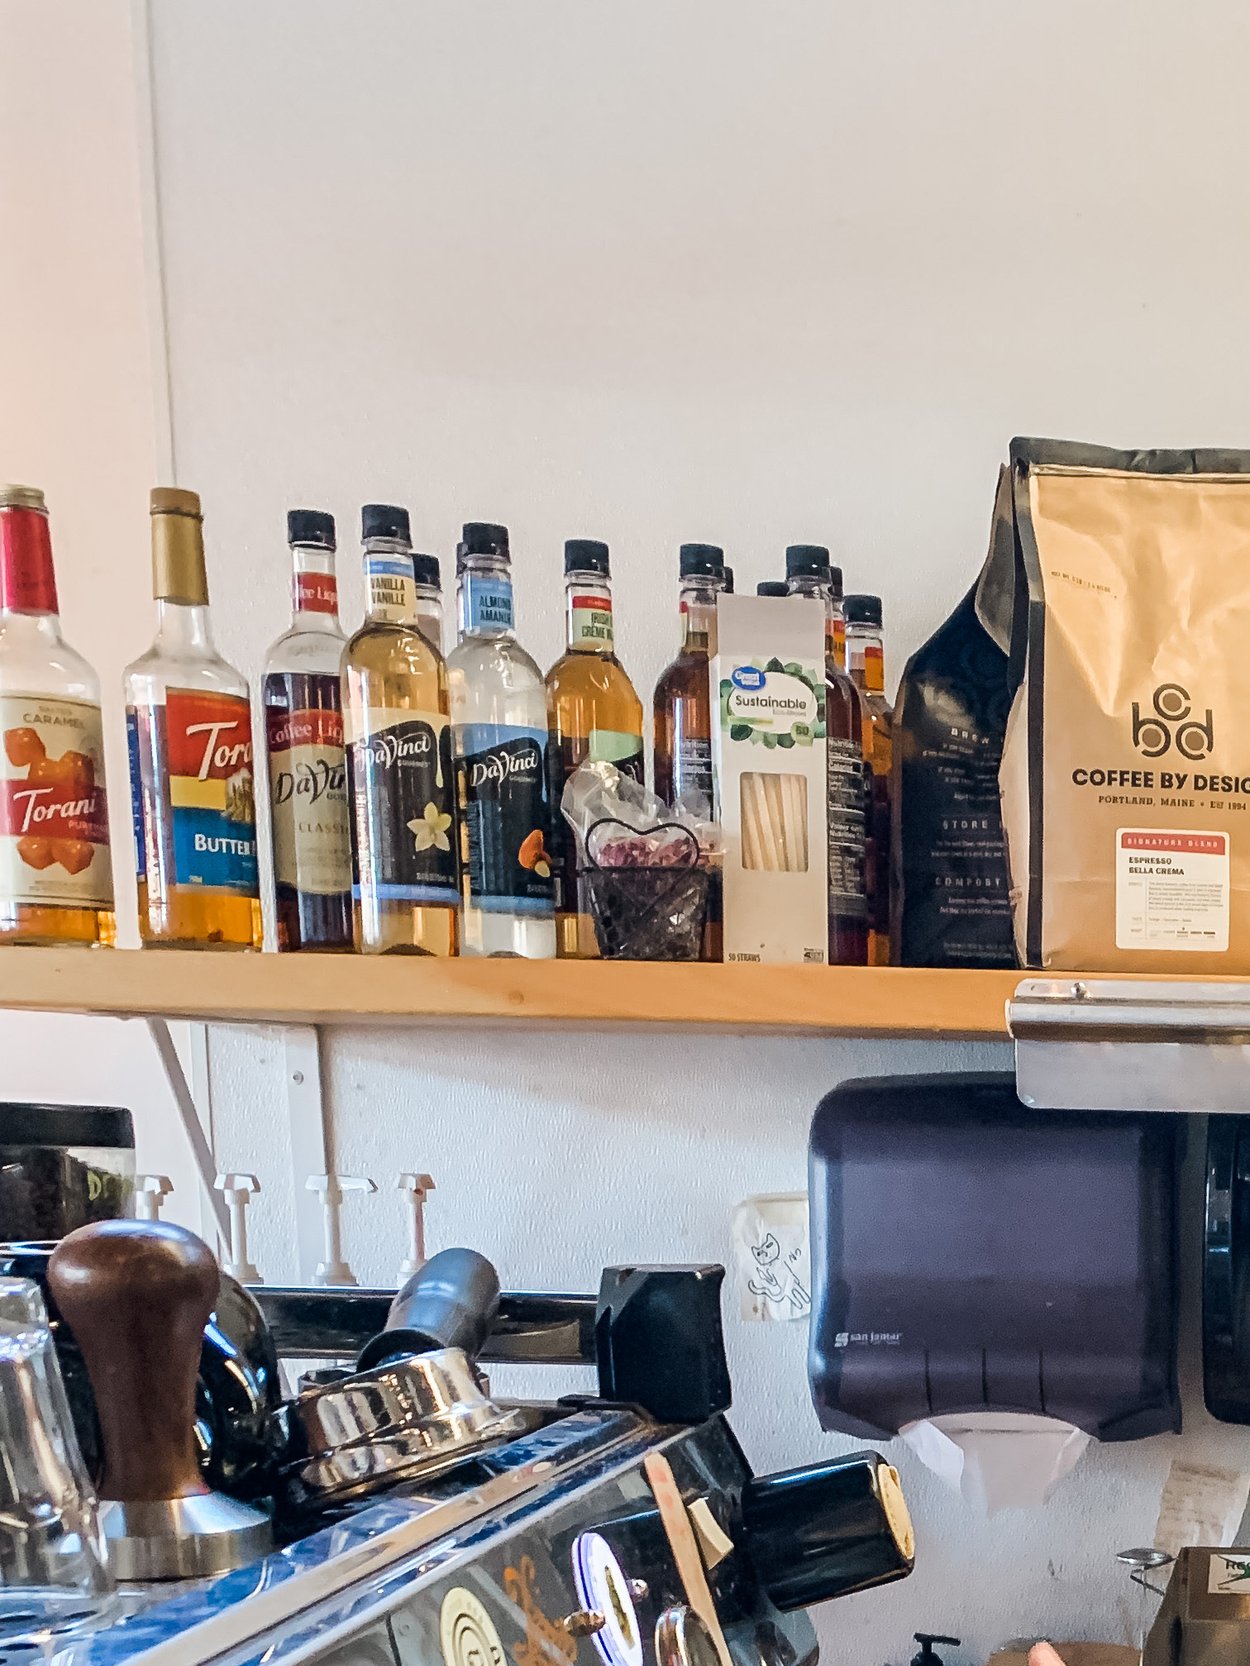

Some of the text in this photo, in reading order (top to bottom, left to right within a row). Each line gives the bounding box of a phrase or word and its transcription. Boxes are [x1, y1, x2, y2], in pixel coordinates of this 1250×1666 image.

[371, 578, 405, 591] VANILLA
[735, 695, 807, 710] Sustainable
[951, 728, 989, 745] BREW
[354, 732, 431, 769] DaVinci
[470, 751, 538, 786] DaVinci
[1072, 768, 1154, 788] COFFEE
[1160, 772, 1188, 790] BY
[1098, 795, 1156, 806] PORTLAND,
[1160, 798, 1195, 807] MAINE
[13, 787, 96, 833] Torani
[942, 820, 988, 830] STORE
[1128, 857, 1172, 865] ESPRESSO
[1128, 867, 1185, 876] BELLA CREMA
[737, 952, 761, 962] STRAWS
